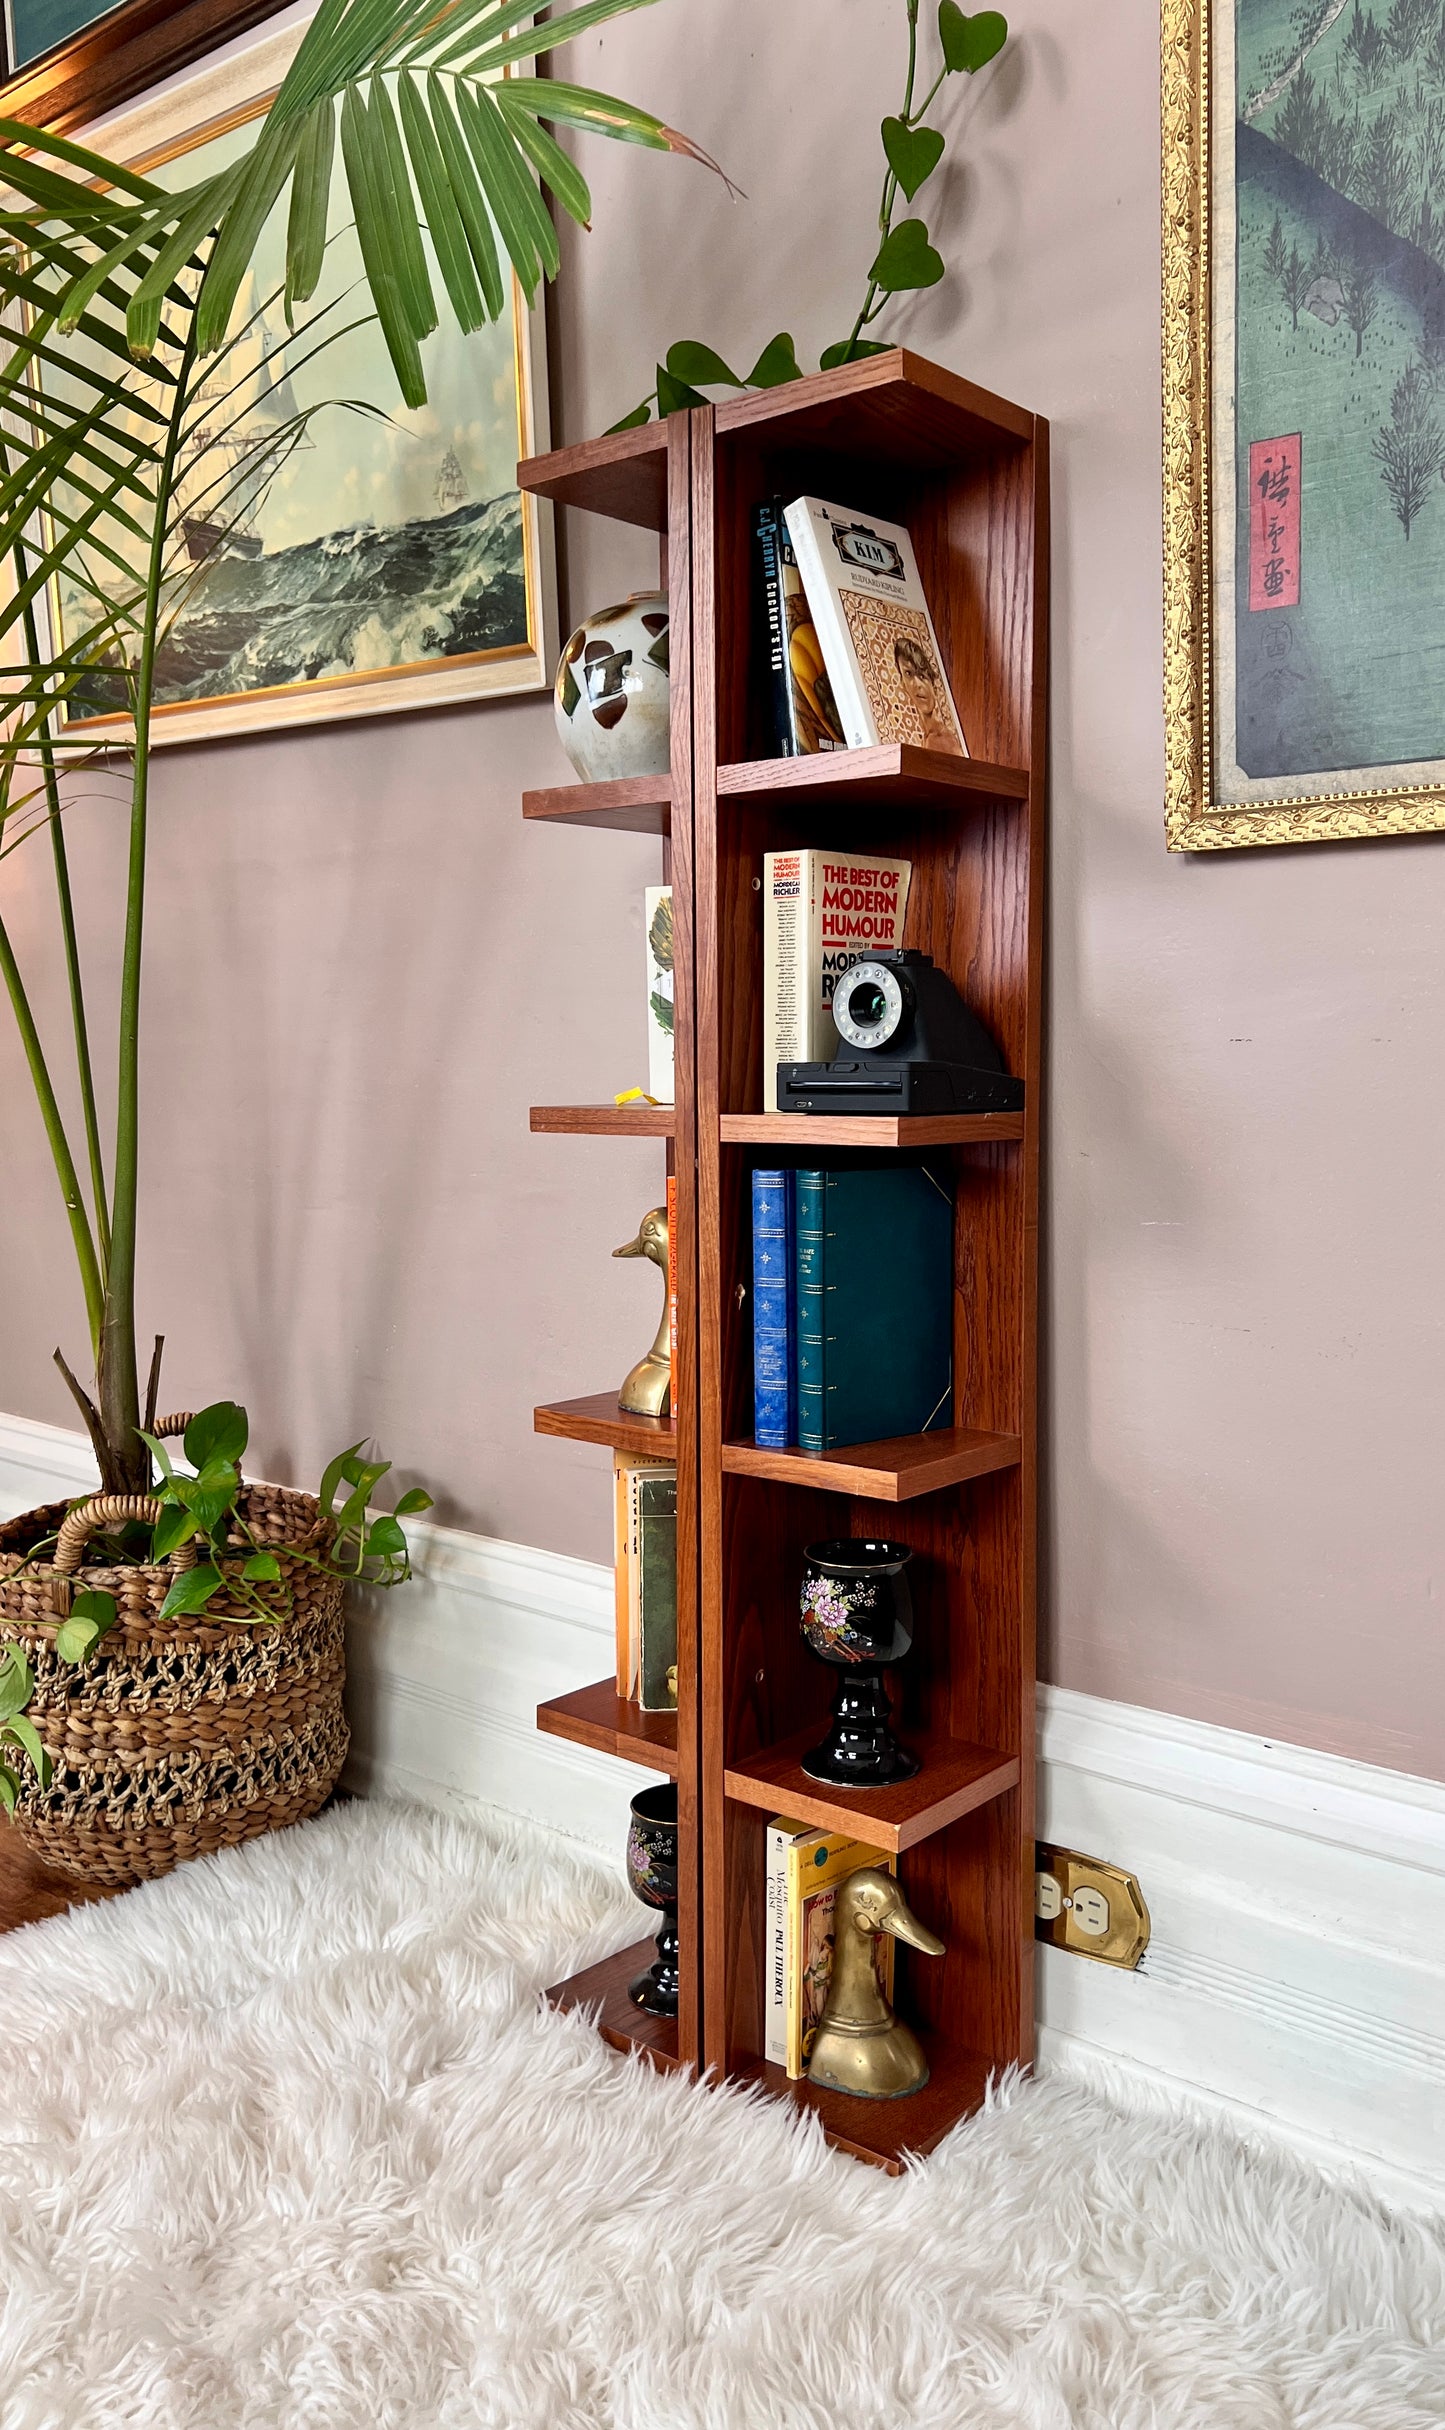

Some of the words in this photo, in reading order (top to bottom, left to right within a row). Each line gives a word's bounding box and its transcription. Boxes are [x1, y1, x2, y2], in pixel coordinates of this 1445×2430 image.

[853, 540, 885, 564] KIM
[773, 863, 800, 871] MODERN
[773, 870, 800, 879] HUMOUR
[822, 864, 849, 885] THE
[850, 867, 880, 888] BEST
[880, 870, 900, 889] OF
[773, 887, 800, 896] RICHLER
[822, 886, 898, 914] MODERN
[822, 913, 896, 939] HUMOUR
[767, 1876, 776, 1909] Coast
[775, 1869, 786, 1924] Mosquito
[825, 1894, 833, 1903] to
[775, 1929, 784, 1953] PAUL
[774, 1956, 784, 2008] THEROUX
